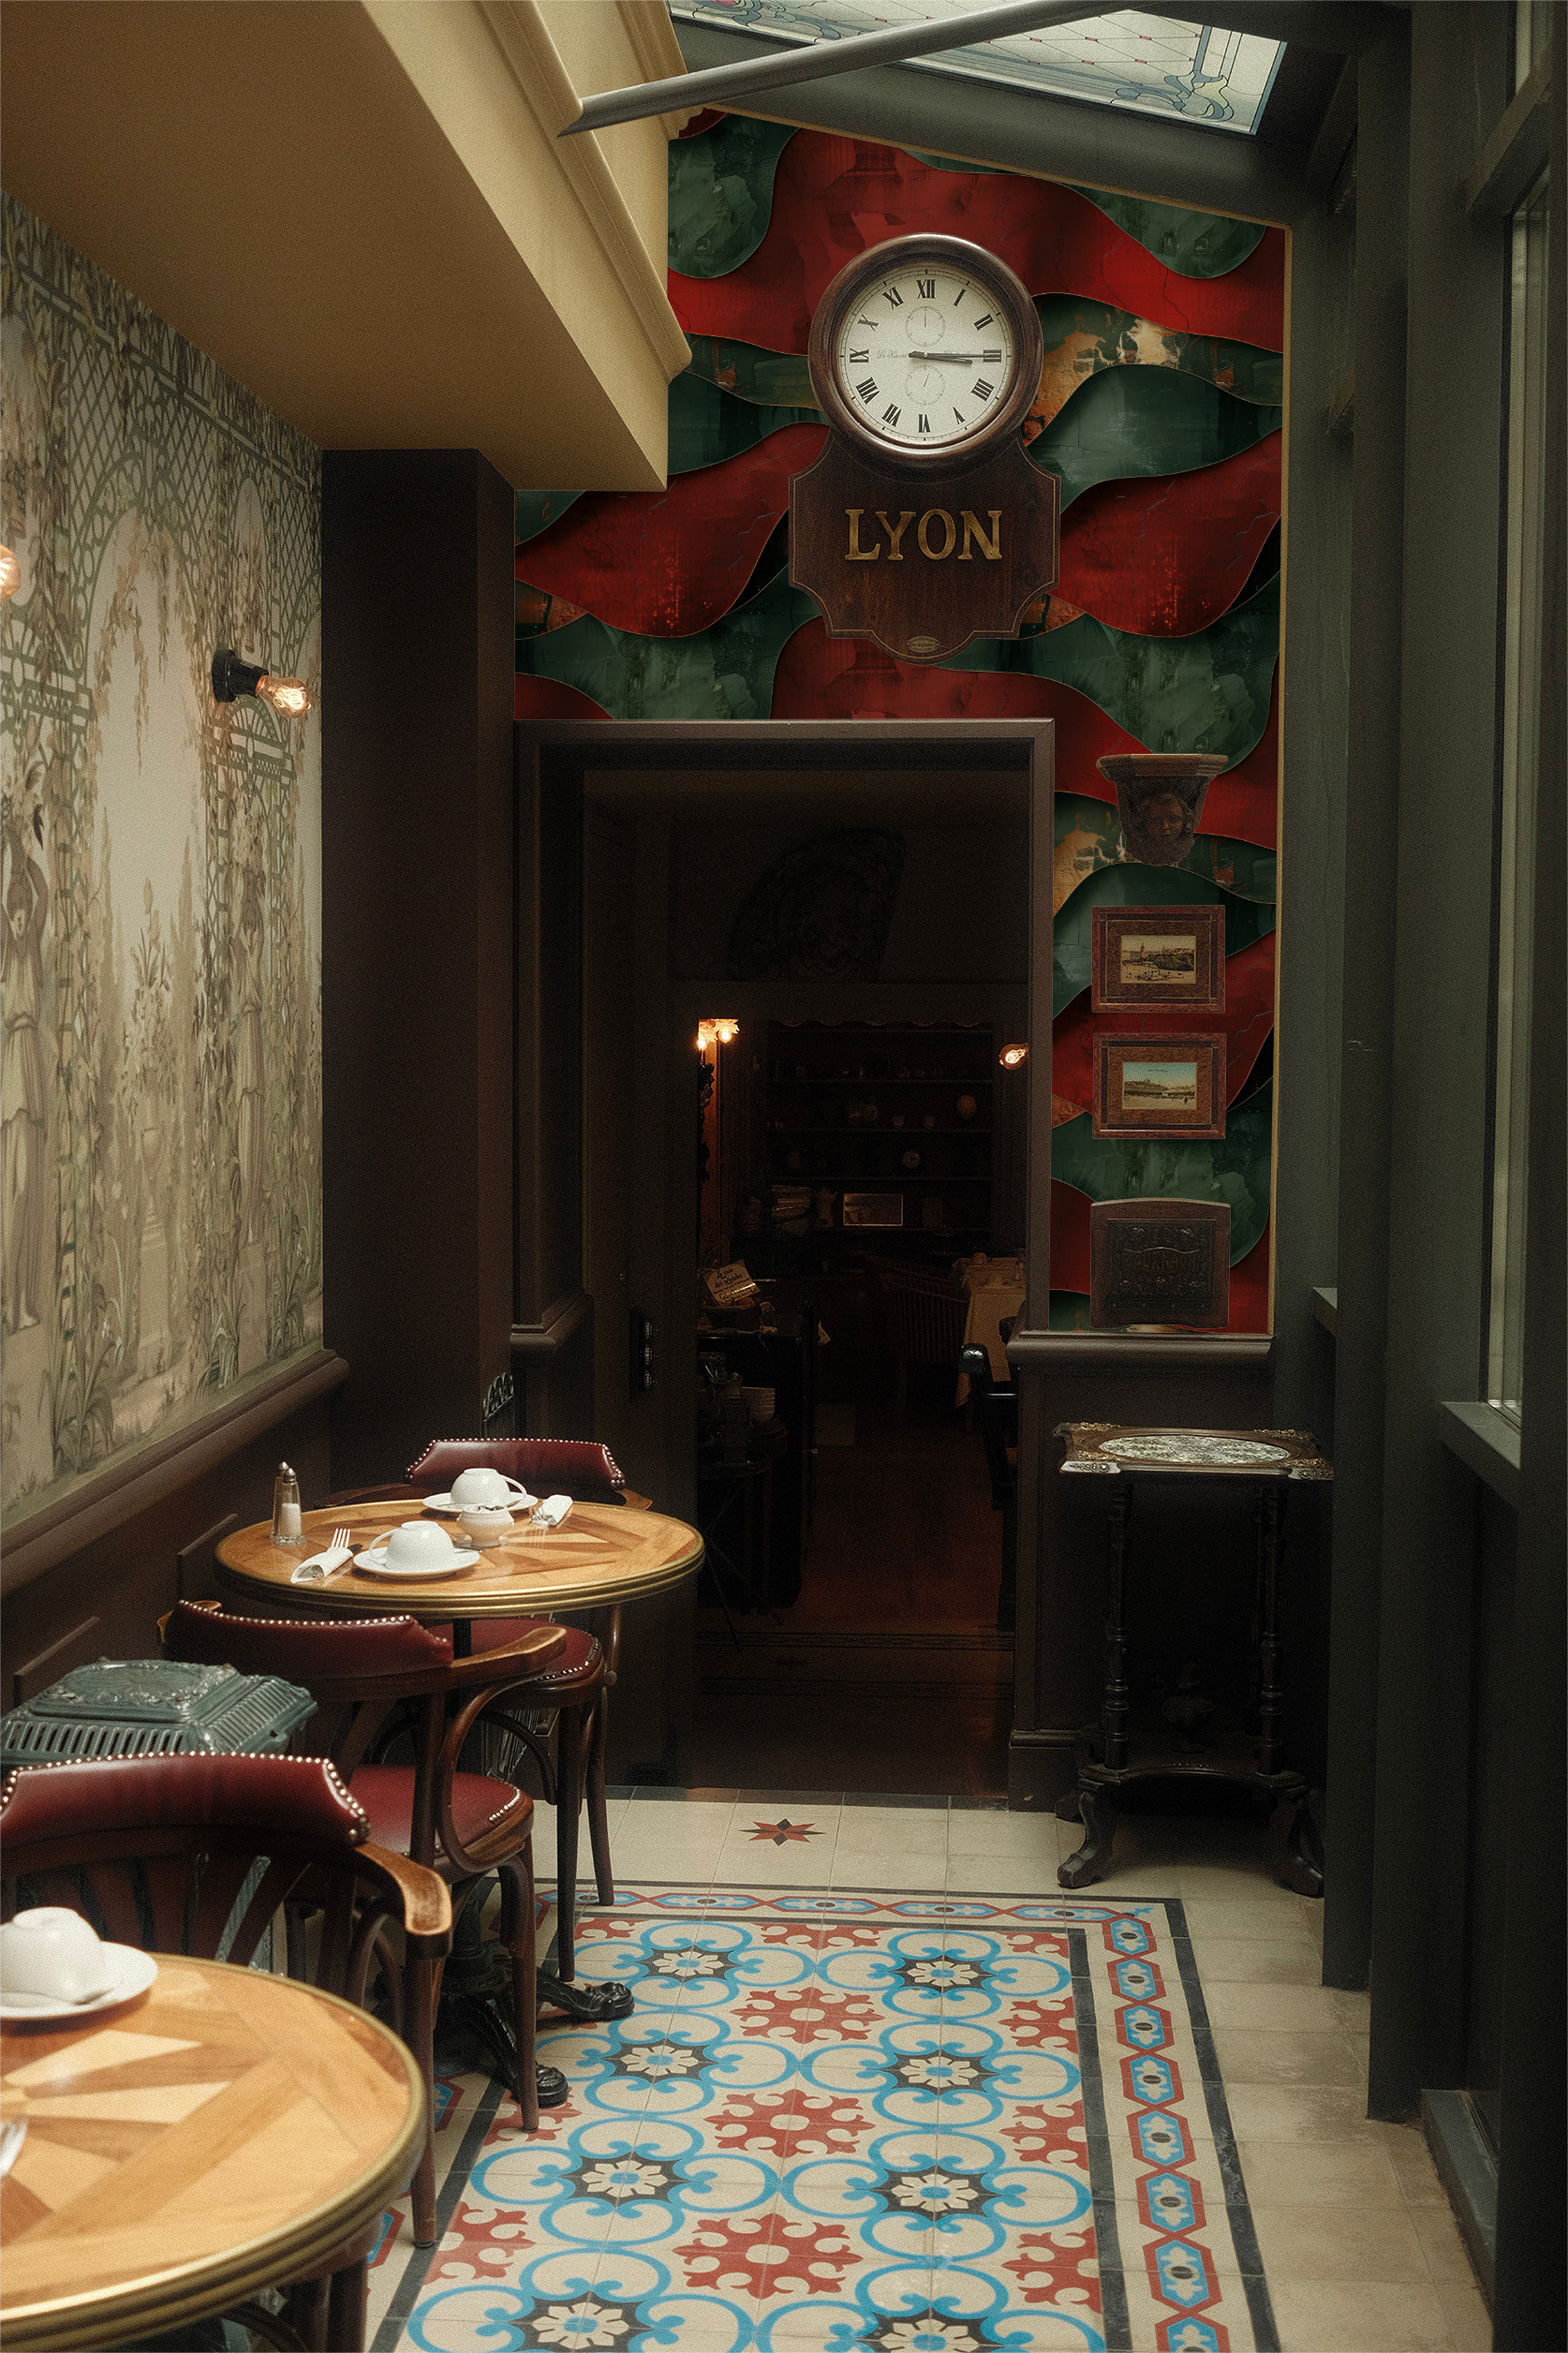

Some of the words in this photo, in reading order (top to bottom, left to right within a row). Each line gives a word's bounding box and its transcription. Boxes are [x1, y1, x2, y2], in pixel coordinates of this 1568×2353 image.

[882, 287, 904, 310] XI
[916, 279, 936, 299] XII
[954, 289, 967, 306] I
[858, 314, 880, 332] X
[973, 314, 994, 331] II
[850, 348, 869, 363] IX
[984, 349, 1001, 363] III
[855, 377, 880, 405] VIII
[970, 377, 995, 402] IIII
[881, 403, 902, 427] VII
[918, 414, 931, 433] VI
[953, 407, 966, 424] V
[844, 508, 1002, 560] LYON
